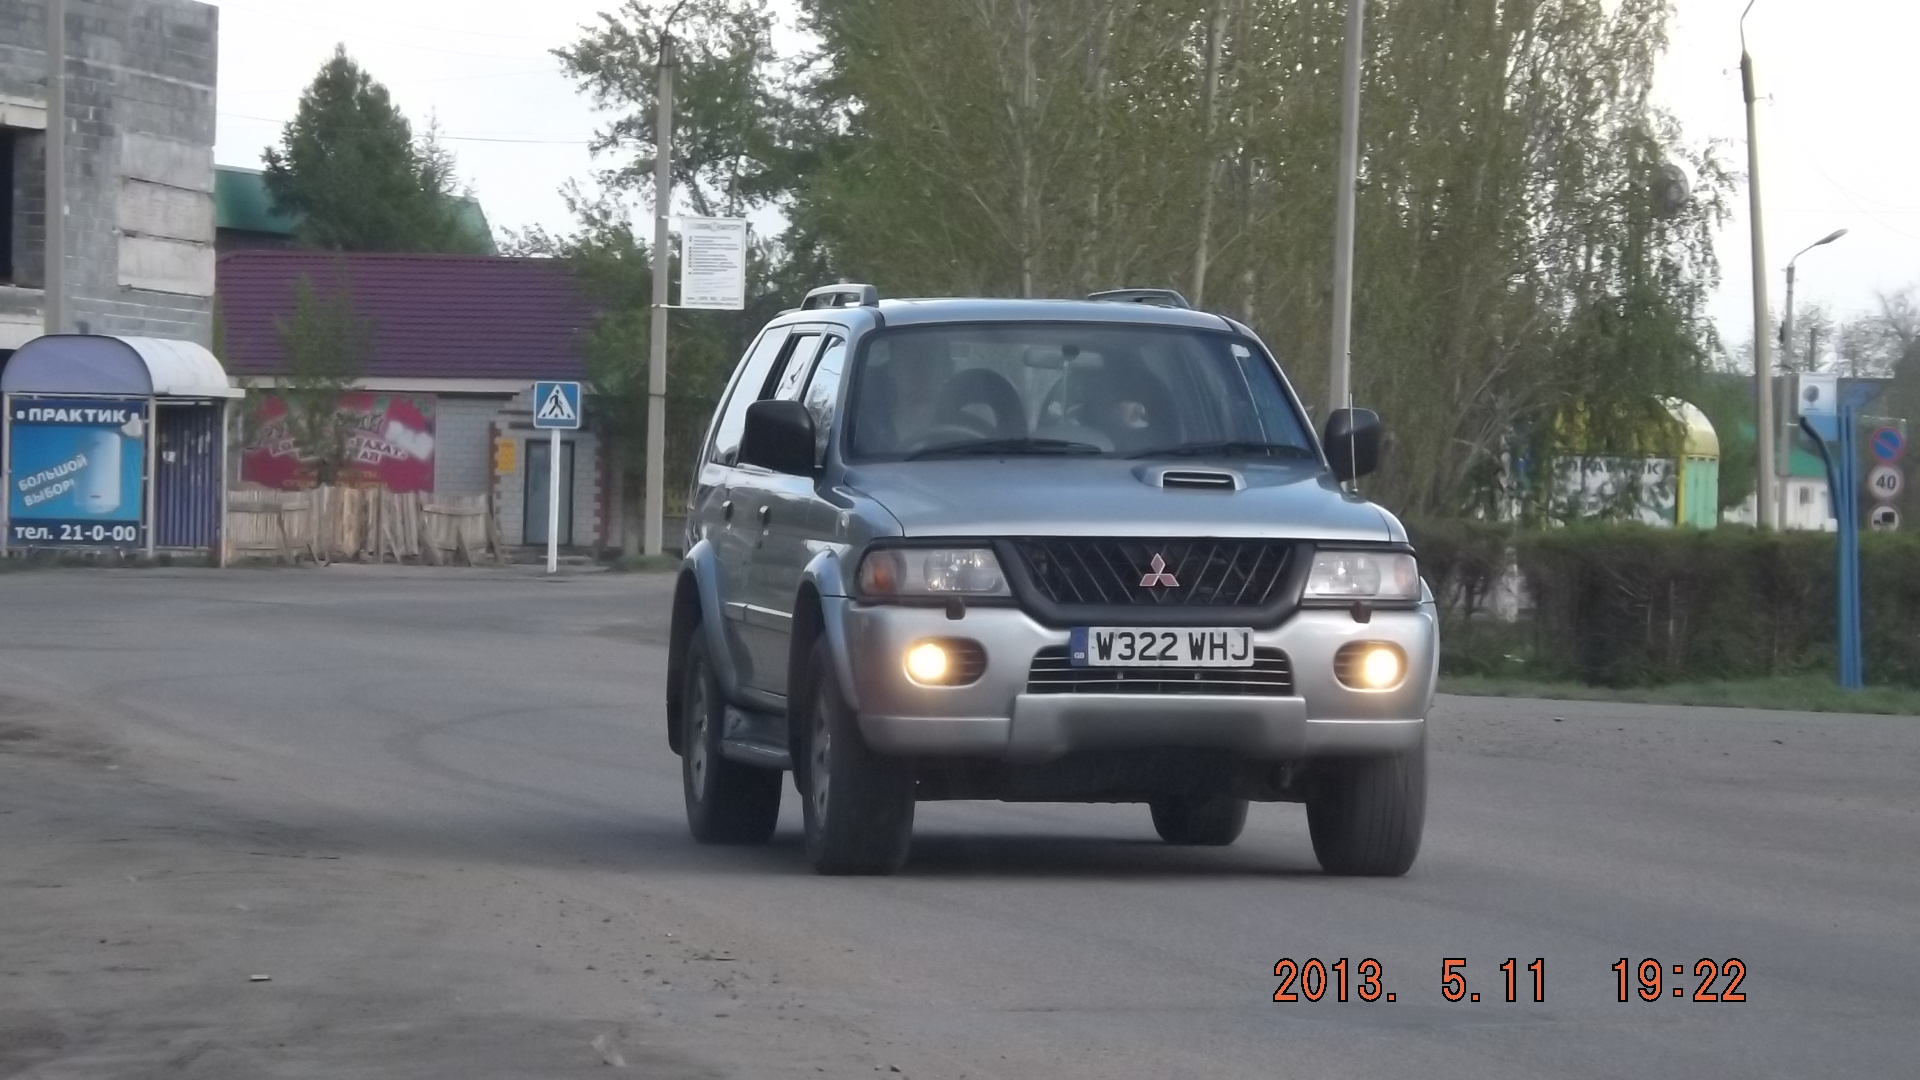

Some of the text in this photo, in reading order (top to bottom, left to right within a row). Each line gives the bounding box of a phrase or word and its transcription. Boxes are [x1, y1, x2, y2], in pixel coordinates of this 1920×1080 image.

[28, 407, 126, 423] ПРАКТИК
[18, 453, 88, 491] БОЛЬШОЙ
[1875, 474, 1897, 491] 40
[14, 524, 137, 541] тел. 21-0-00
[1096, 631, 1249, 661] W322 WHJ
